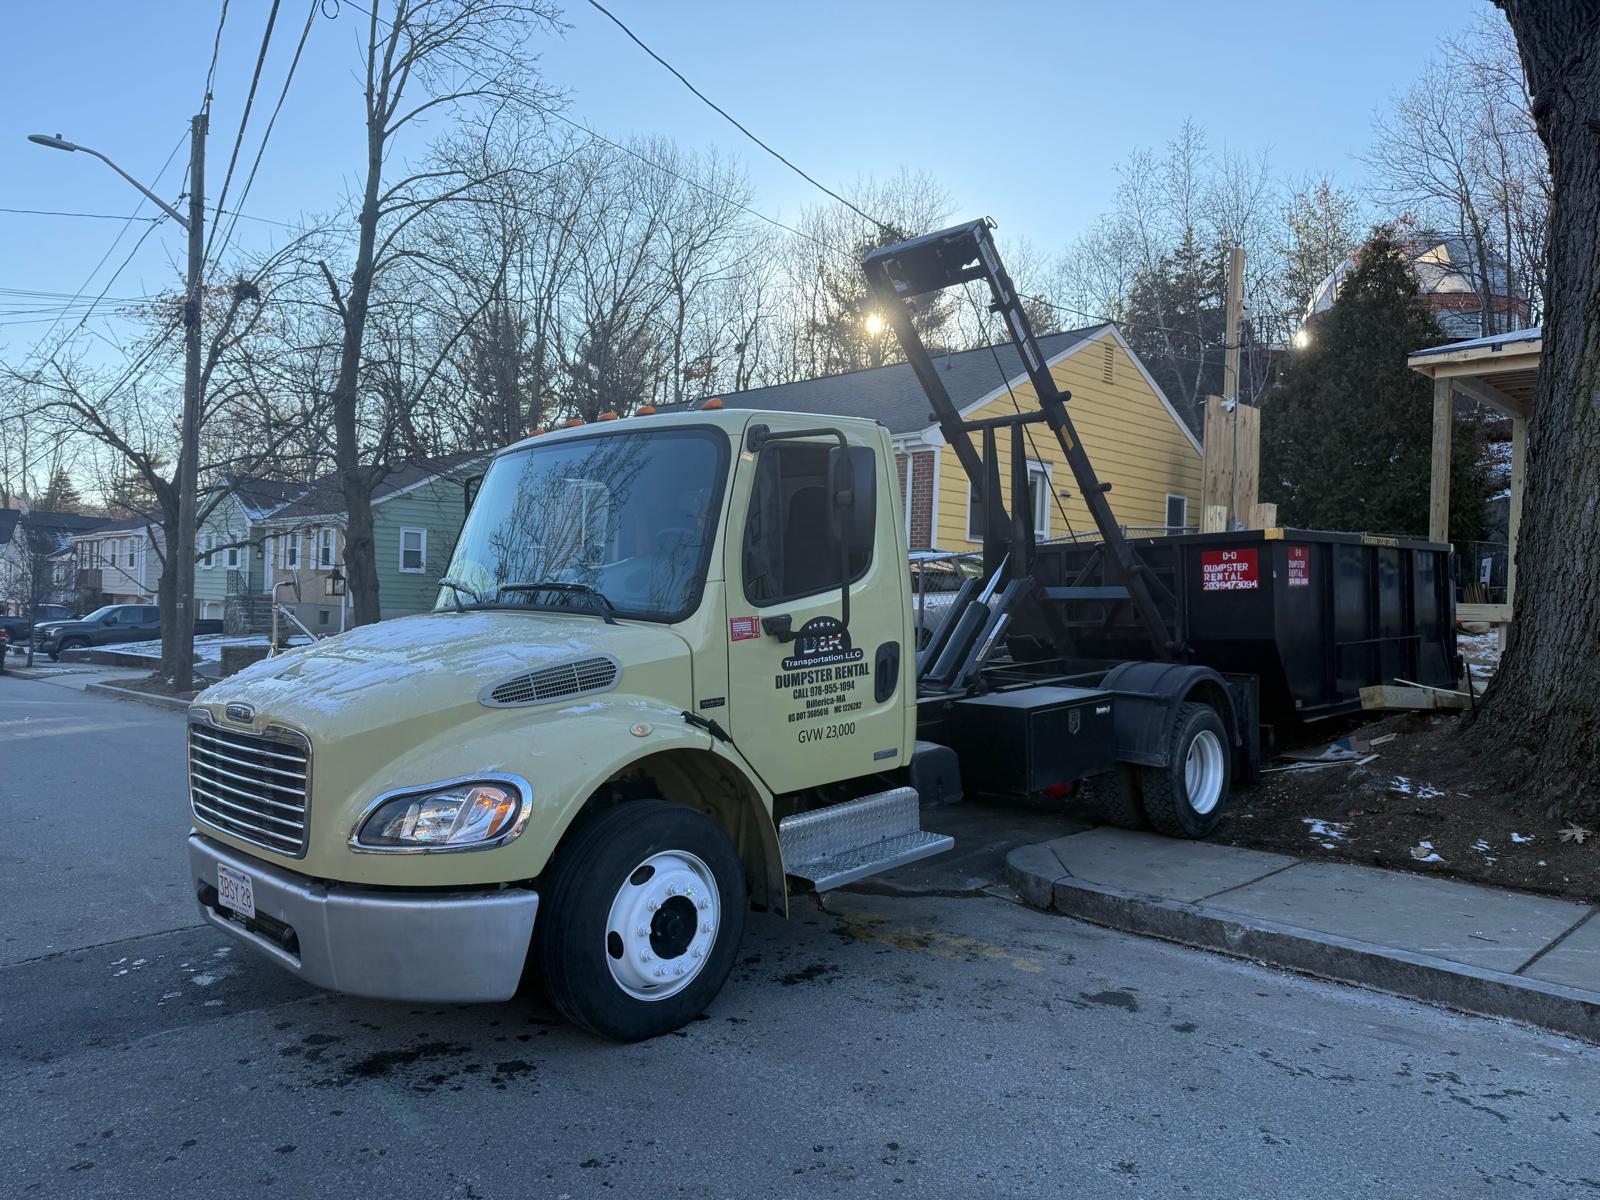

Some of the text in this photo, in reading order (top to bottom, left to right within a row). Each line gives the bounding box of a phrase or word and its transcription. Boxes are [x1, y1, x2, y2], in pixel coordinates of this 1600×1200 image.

[1203, 562, 1249, 573] DUMPSTER
[1203, 572, 1243, 582] RENTAL
[784, 650, 861, 668] Transportation LLC
[775, 662, 869, 689] DUMPSTER RENTAL
[793, 680, 855, 700] CALL 978-955-1094
[806, 694, 846, 708] Billerica-MA
[788, 713, 796, 722] US
[796, 711, 806, 721] DOT
[834, 705, 842, 713] MC
[798, 722, 856, 744] GVW 23,000
[241, 885, 251, 908] 28
